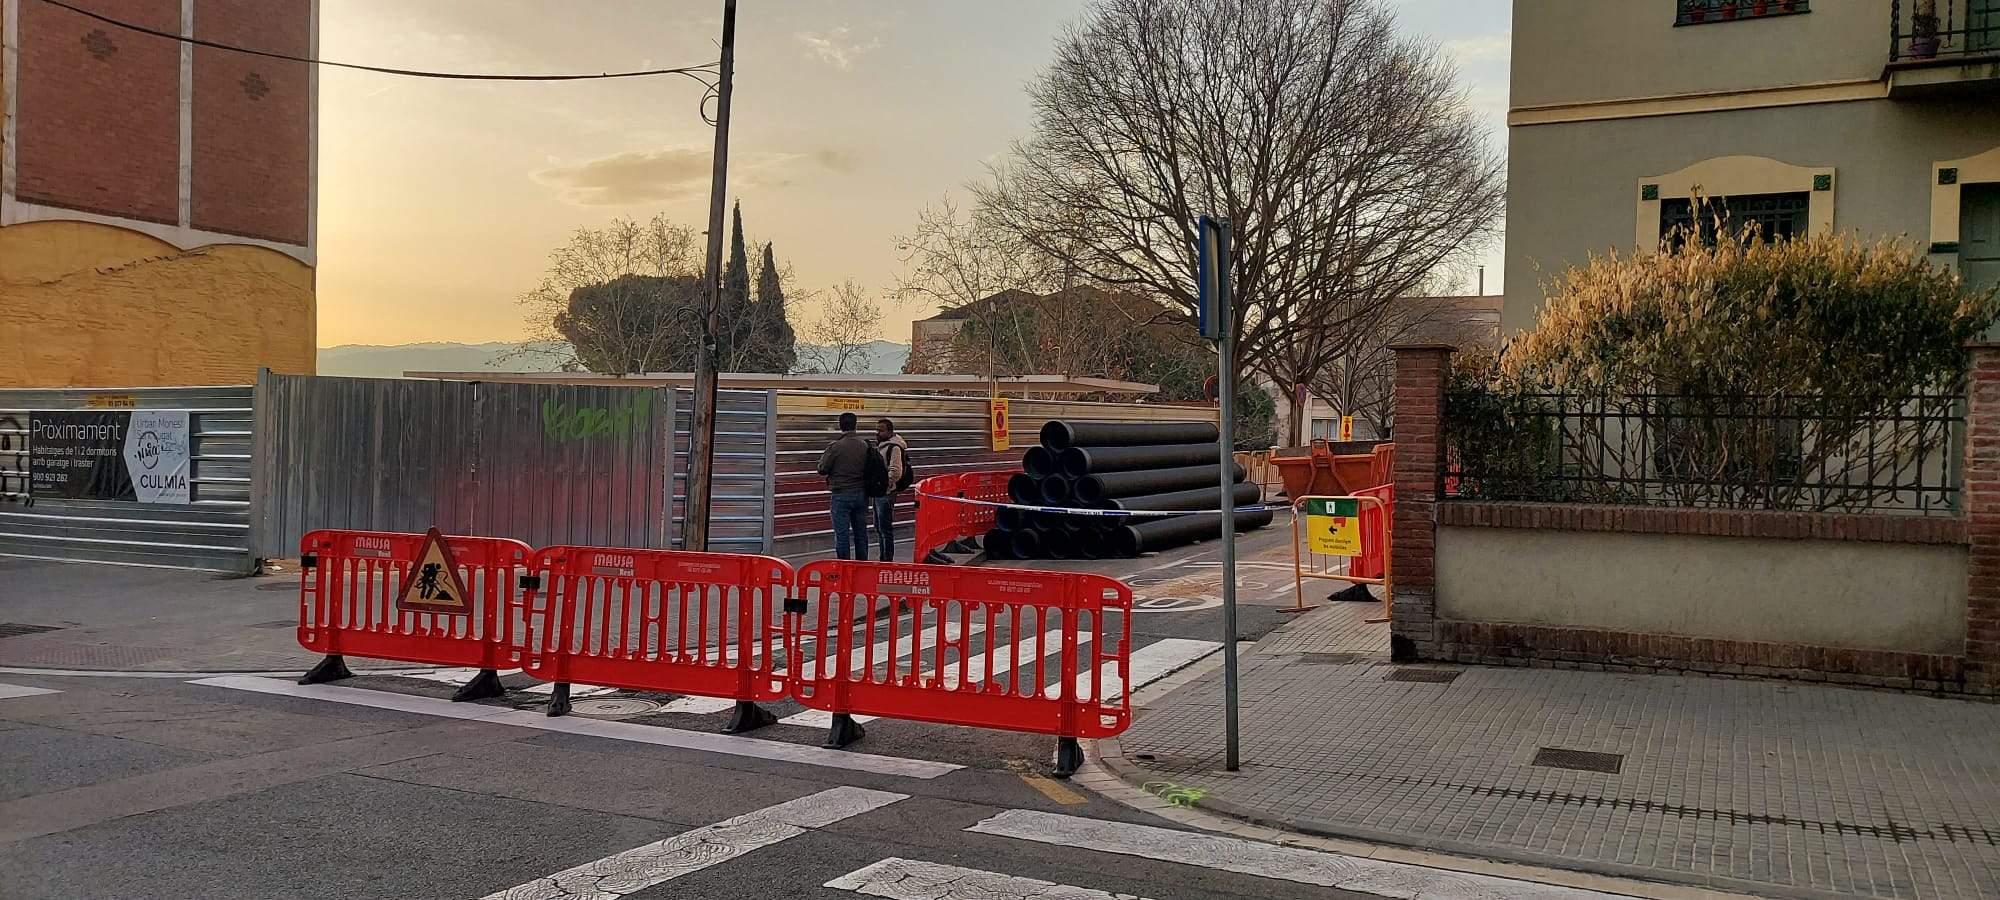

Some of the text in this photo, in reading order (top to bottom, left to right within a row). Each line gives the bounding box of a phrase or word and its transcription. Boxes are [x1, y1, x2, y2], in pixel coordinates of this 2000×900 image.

[33, 419, 120, 440] Pròximament
[81, 446, 85, 455] 2
[140, 475, 186, 490] CULMIA
[354, 536, 391, 550] MAUSA
[593, 553, 634, 568] MAUSA
[878, 570, 930, 585] MAUSA
[911, 586, 930, 595] Rent
